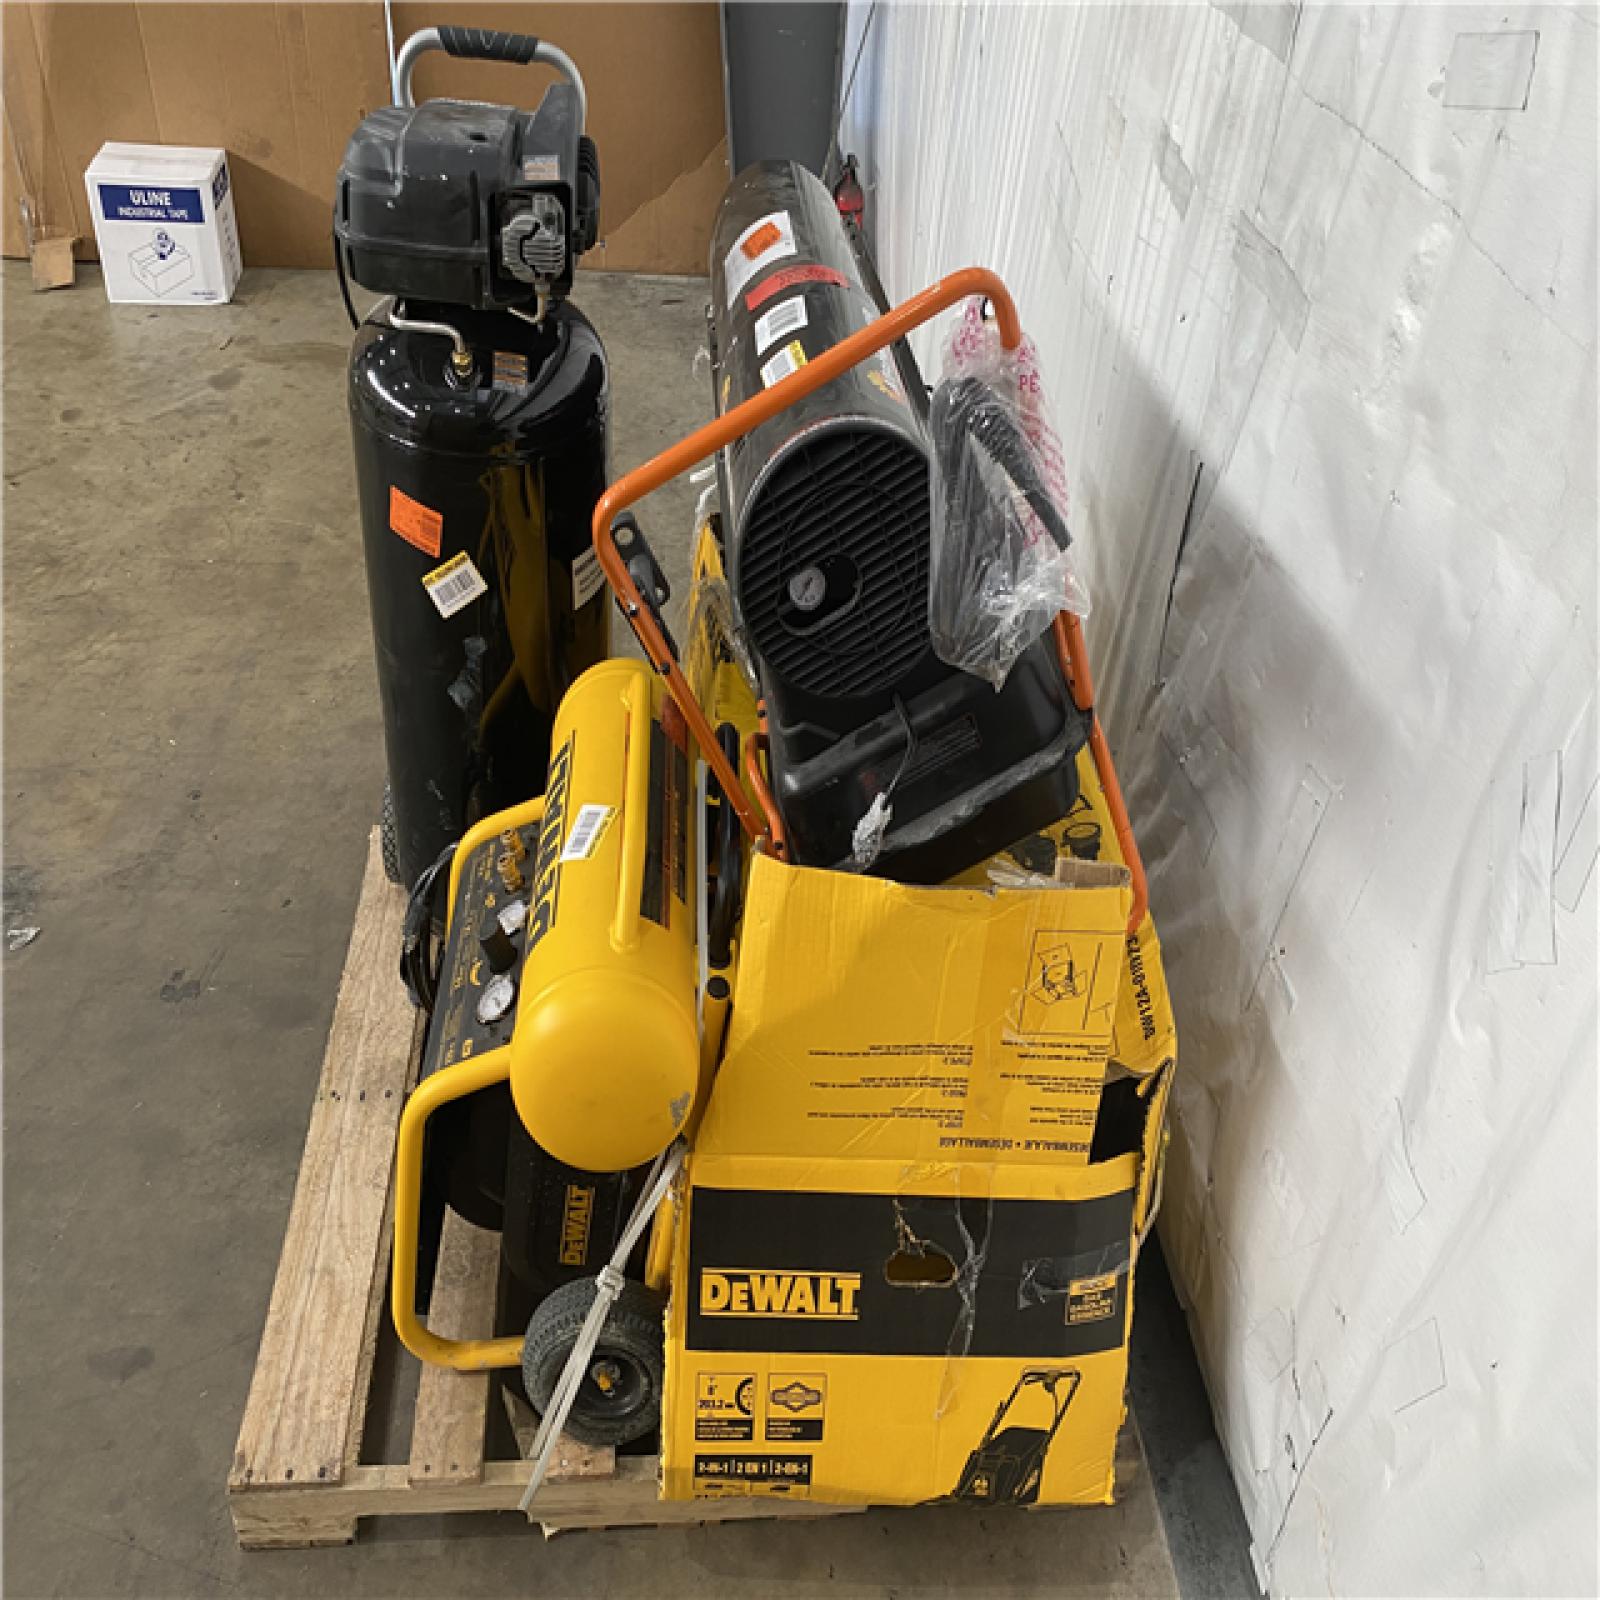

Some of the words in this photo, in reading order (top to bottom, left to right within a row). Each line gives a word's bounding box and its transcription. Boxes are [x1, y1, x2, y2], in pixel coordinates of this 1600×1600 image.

[129, 189, 171, 206] ULINE
[118, 206, 168, 218] INDUSTRIAL
[167, 209, 189, 221] TAPE
[562, 1186, 594, 1265] DEWALT
[701, 1272, 861, 1315] DEWALT
